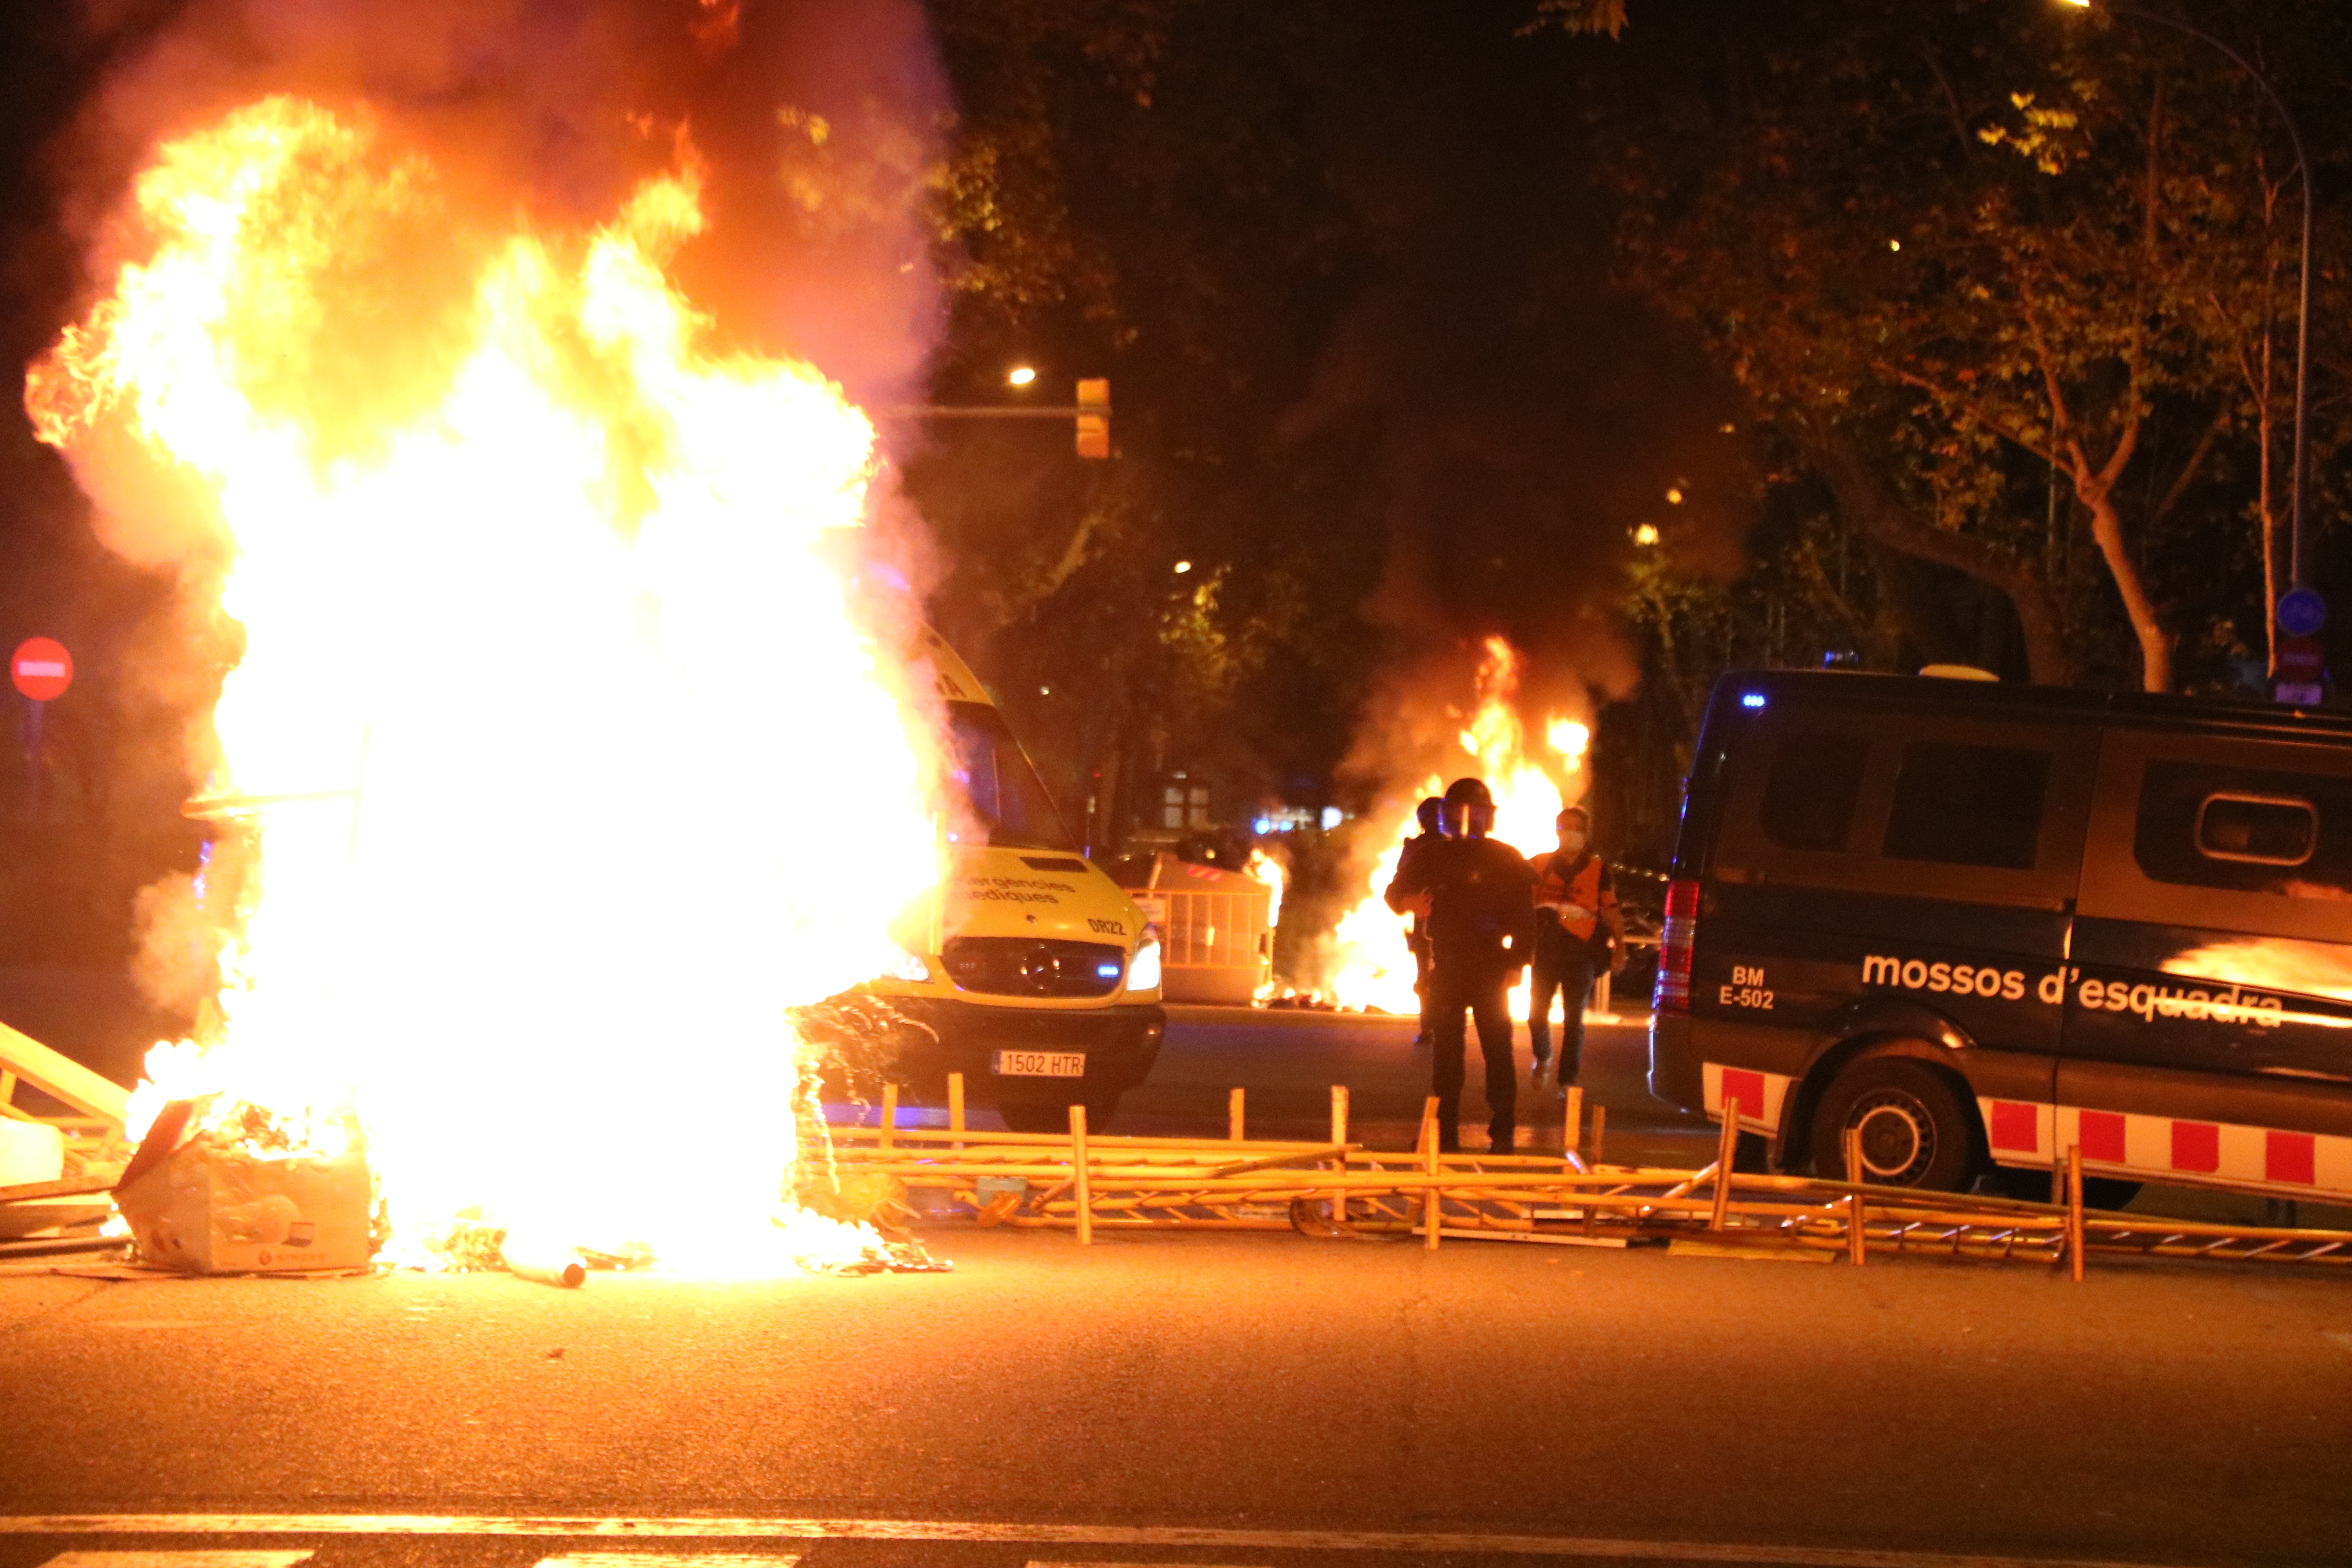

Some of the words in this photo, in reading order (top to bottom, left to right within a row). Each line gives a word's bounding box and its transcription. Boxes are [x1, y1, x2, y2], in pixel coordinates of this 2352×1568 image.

[1087, 918, 1127, 936] DR22
[1732, 965, 1764, 987] BM
[1719, 985, 1774, 1010] E-502
[1862, 954, 2026, 1001] mossos
[2038, 966, 2283, 1028] d'esquadra
[1008, 1054, 1045, 1073] 1502
[1051, 1056, 1081, 1074] HTR
